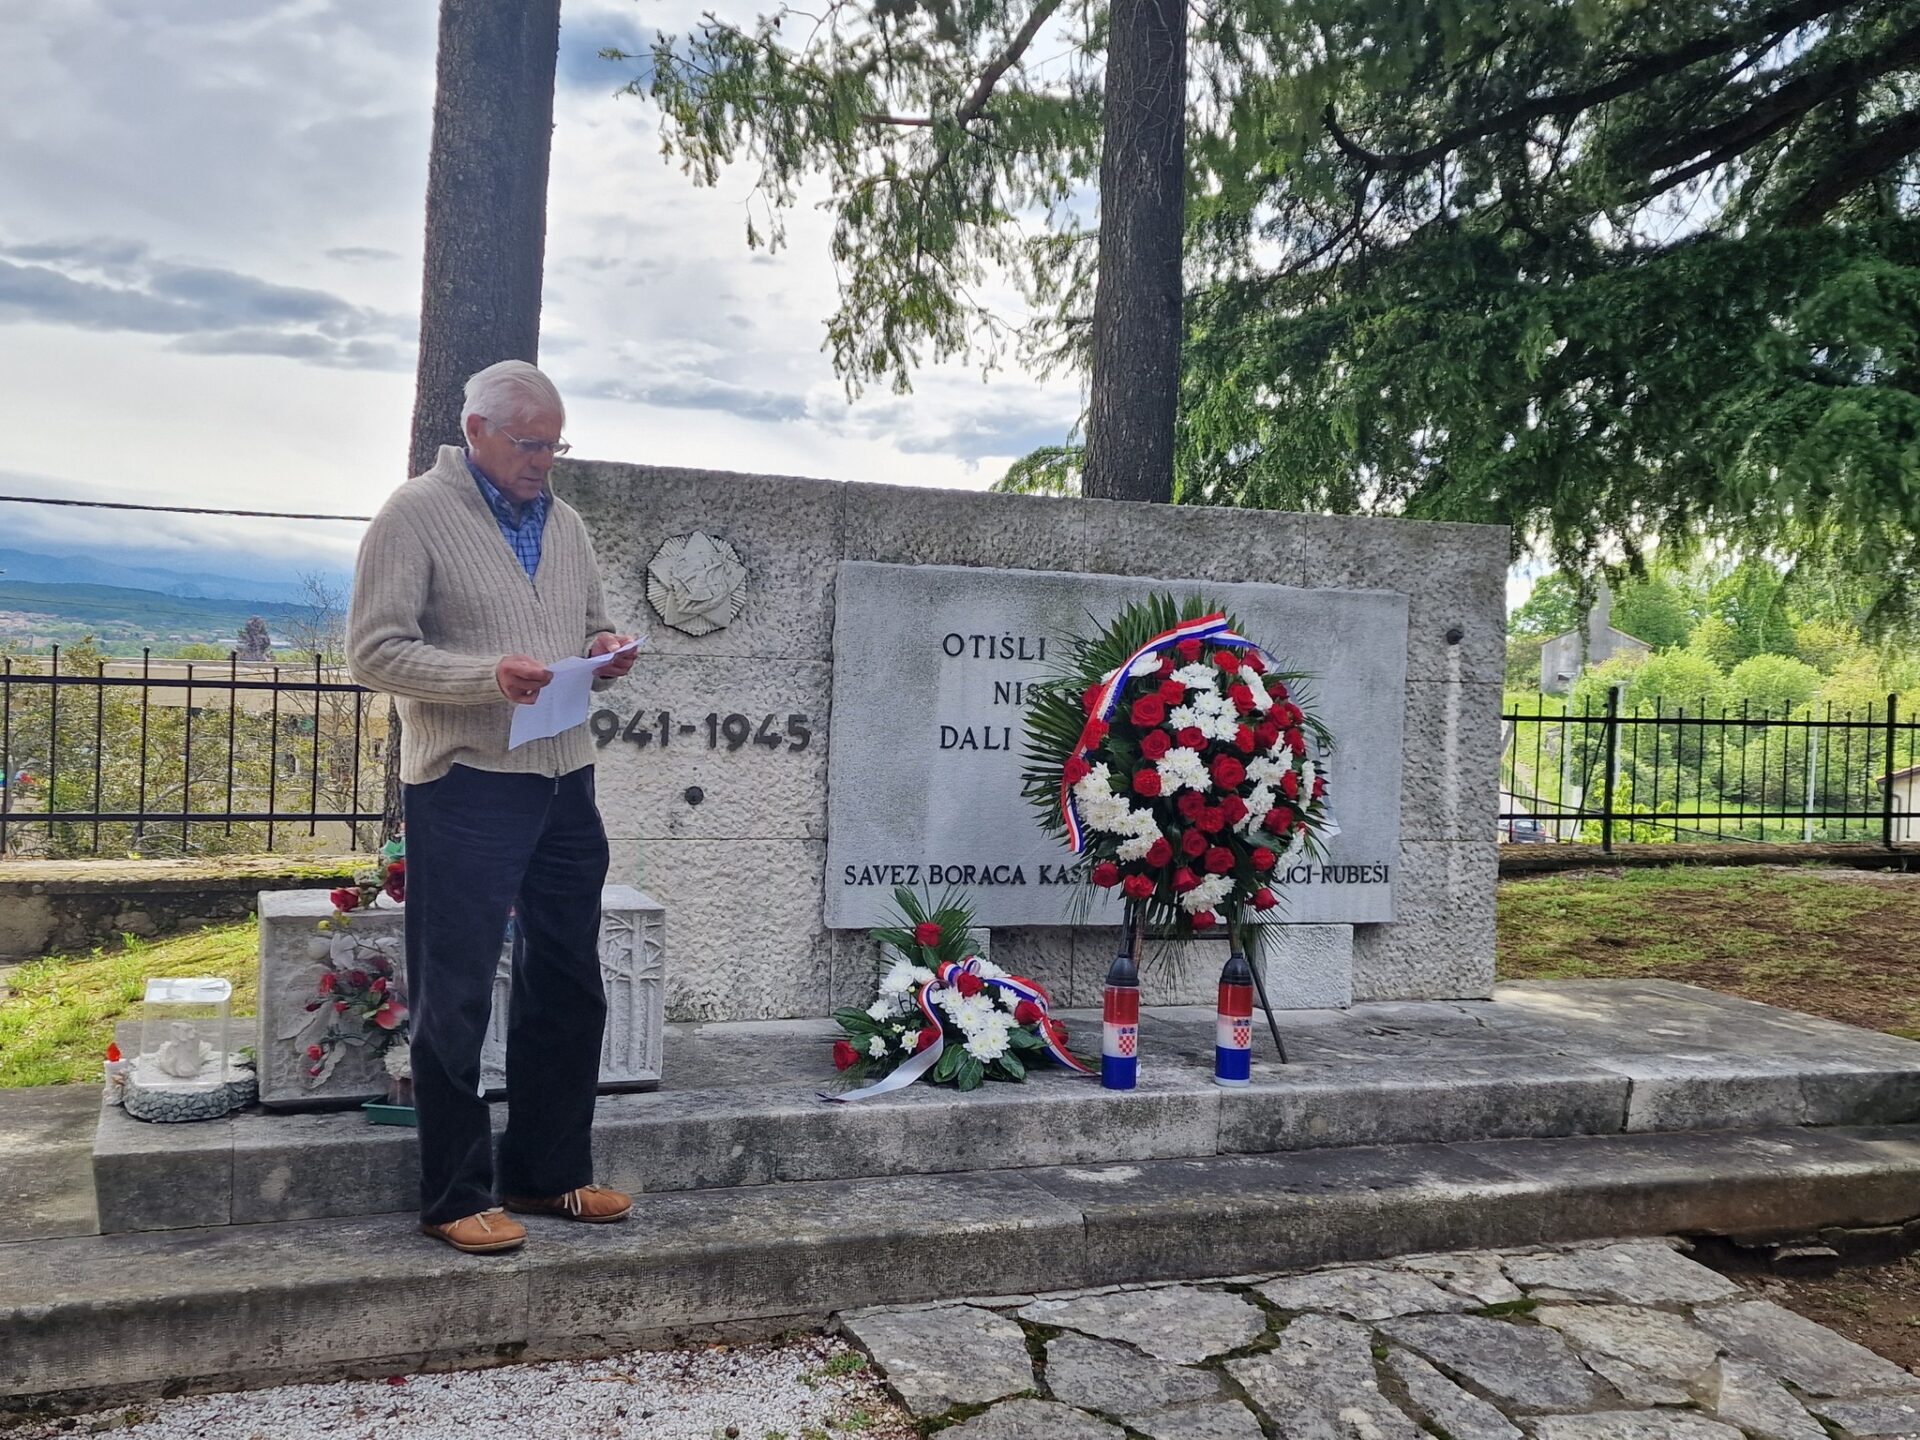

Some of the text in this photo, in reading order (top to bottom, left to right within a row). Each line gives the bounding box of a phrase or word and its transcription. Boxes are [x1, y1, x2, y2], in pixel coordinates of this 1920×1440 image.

[942, 631, 1046, 661] OTIŠLI
[993, 681, 1041, 706] NIS
[589, 708, 811, 751] 941-1945
[940, 725, 1011, 751] DALI
[844, 860, 1390, 886] SAVEZ BORACA KAST IĆI-RUBEŠI
